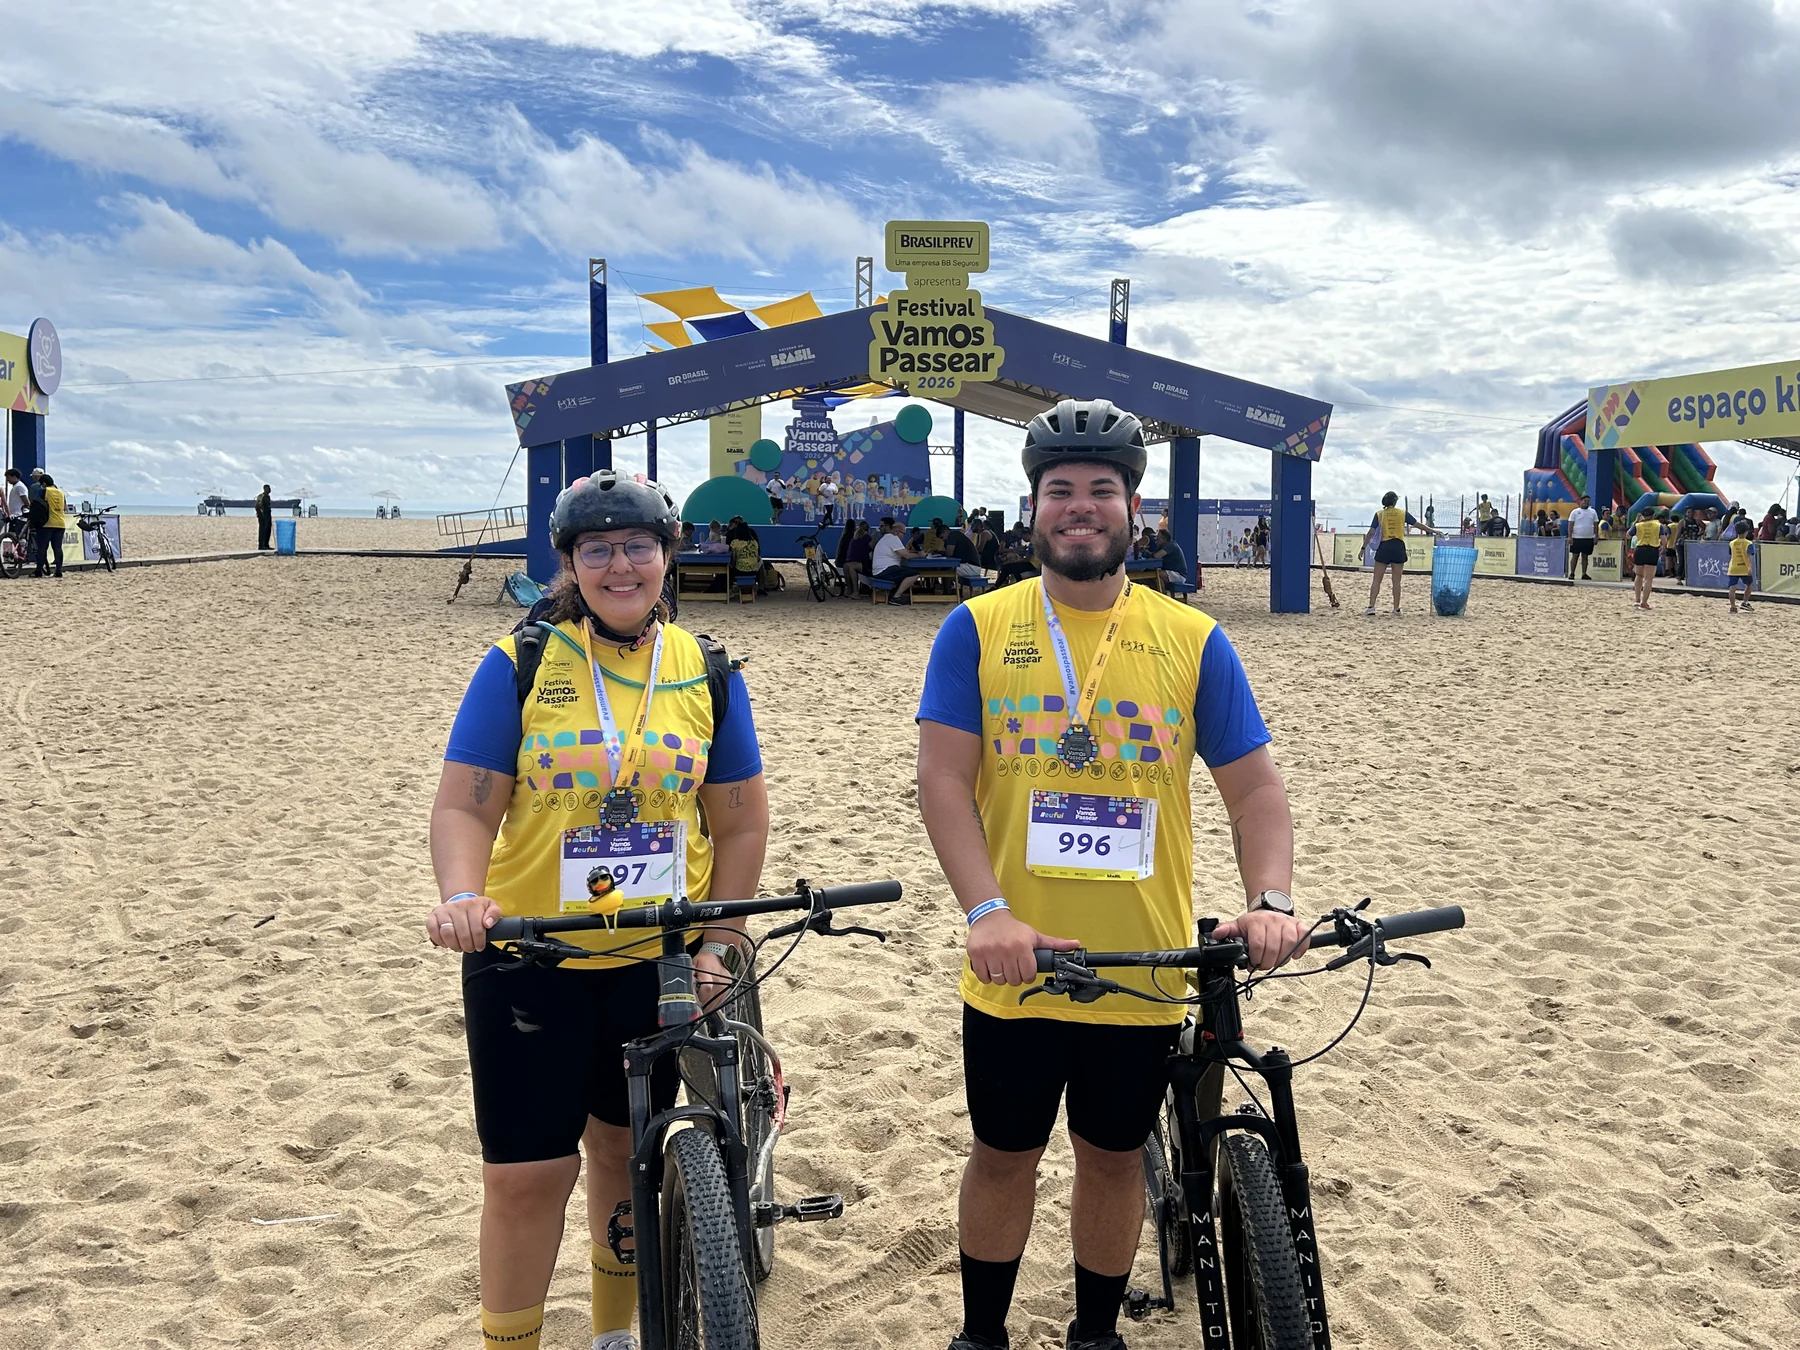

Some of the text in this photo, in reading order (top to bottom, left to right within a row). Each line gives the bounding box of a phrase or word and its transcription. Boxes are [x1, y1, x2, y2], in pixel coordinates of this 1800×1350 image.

[900, 234, 974, 248] BRASILPREV
[912, 260, 940, 268] empresa
[952, 260, 979, 268] Seguros
[914, 277, 961, 288] apresenta
[898, 298, 975, 316] Festival
[881, 320, 984, 348] Vamos
[770, 348, 816, 367] BRASIL
[880, 348, 996, 372] Passear
[668, 370, 708, 386] BR BRASIL
[918, 377, 955, 388] 2026
[1152, 382, 1189, 396] BR BRASIL
[1668, 388, 1766, 428] espaço
[796, 420, 830, 428] Festival
[1246, 406, 1286, 428] BRASIL
[789, 429, 834, 442] Vamos
[788, 440, 838, 452] Passear
[1592, 557, 1617, 568] BRASIL
[1780, 564, 1795, 576] BR
[1004, 648, 1039, 656] Vamos
[1004, 656, 1042, 665] Passear
[1058, 638, 1076, 695] #vamospassear
[538, 687, 576, 696] Vamos
[536, 695, 580, 704] Passear
[1058, 832, 1110, 856] 996
[600, 863, 648, 886] 97
[1192, 1212, 1225, 1350] MANITO
[1290, 1206, 1326, 1350] MANITO
